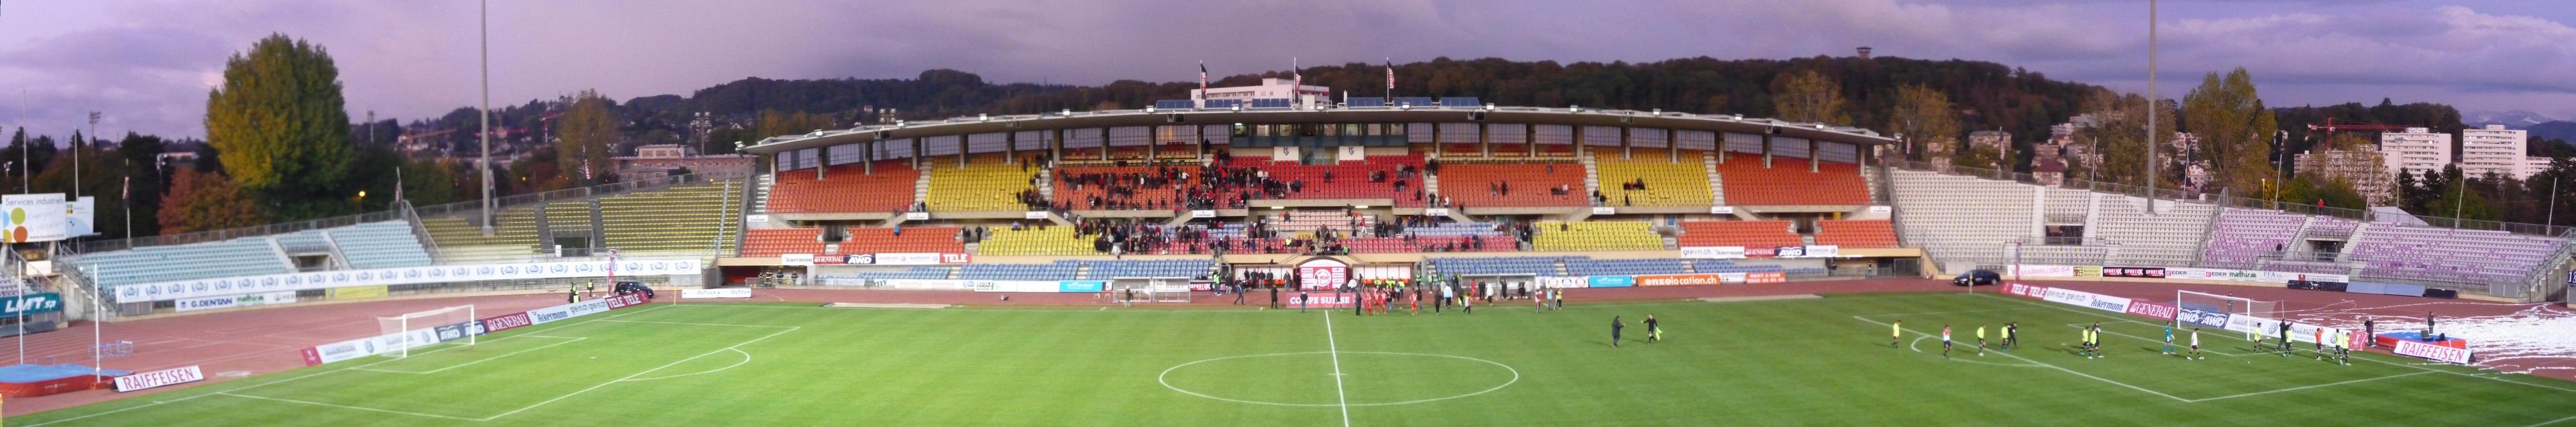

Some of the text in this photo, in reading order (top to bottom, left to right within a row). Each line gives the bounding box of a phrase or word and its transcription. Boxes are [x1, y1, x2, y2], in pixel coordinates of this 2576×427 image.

[6, 198, 34, 206] Services
[943, 253, 967, 263] TELE
[1646, 276, 1717, 286] enzolocation.ch
[2011, 283, 2047, 298] TELE TELE
[5, 296, 46, 313] LMT
[191, 298, 233, 308] G.DENTAN
[606, 293, 641, 308] TELE TELE
[2091, 299, 2124, 312] Ackermann
[537, 310, 568, 322] Ackermann
[2136, 302, 2175, 319] GENERALI
[492, 314, 529, 330] GENERALI
[2176, 312, 2227, 327] AWD AWD
[440, 328, 460, 341] AWD
[2401, 342, 2465, 362] RAIFFEISEN
[123, 368, 195, 390] RAIFFEISEN
